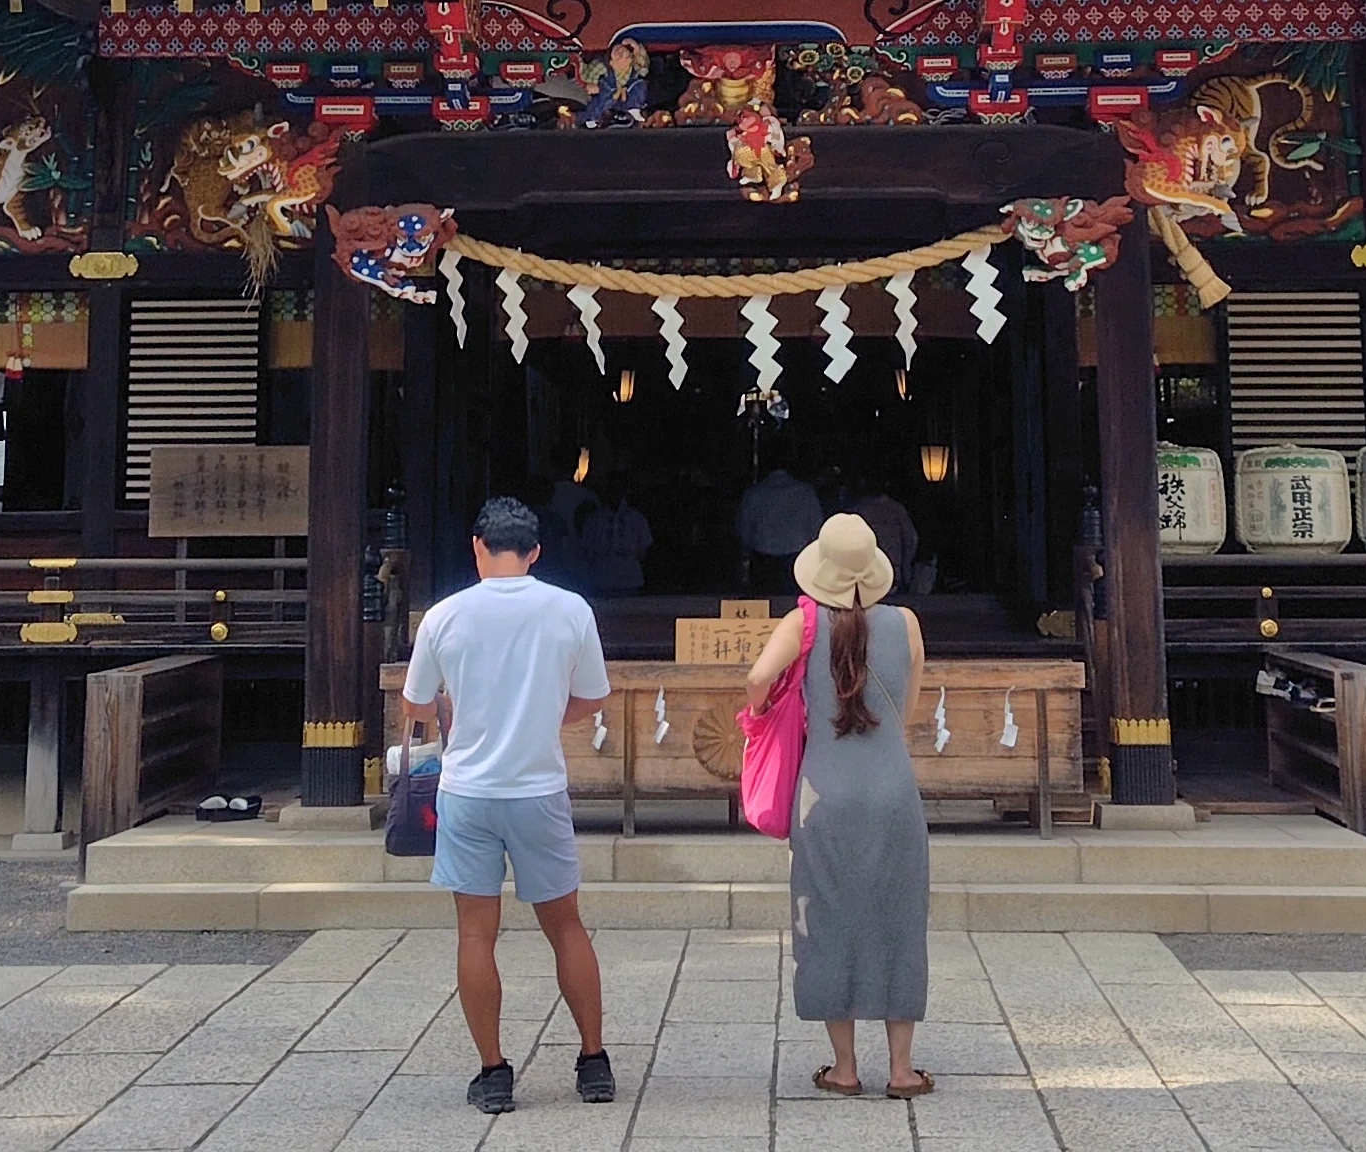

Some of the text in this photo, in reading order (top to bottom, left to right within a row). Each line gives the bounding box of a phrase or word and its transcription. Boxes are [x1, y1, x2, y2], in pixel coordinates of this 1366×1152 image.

[1158, 472, 1186, 541] 秩父錦
[1290, 475, 1314, 538] 武甲正宗
